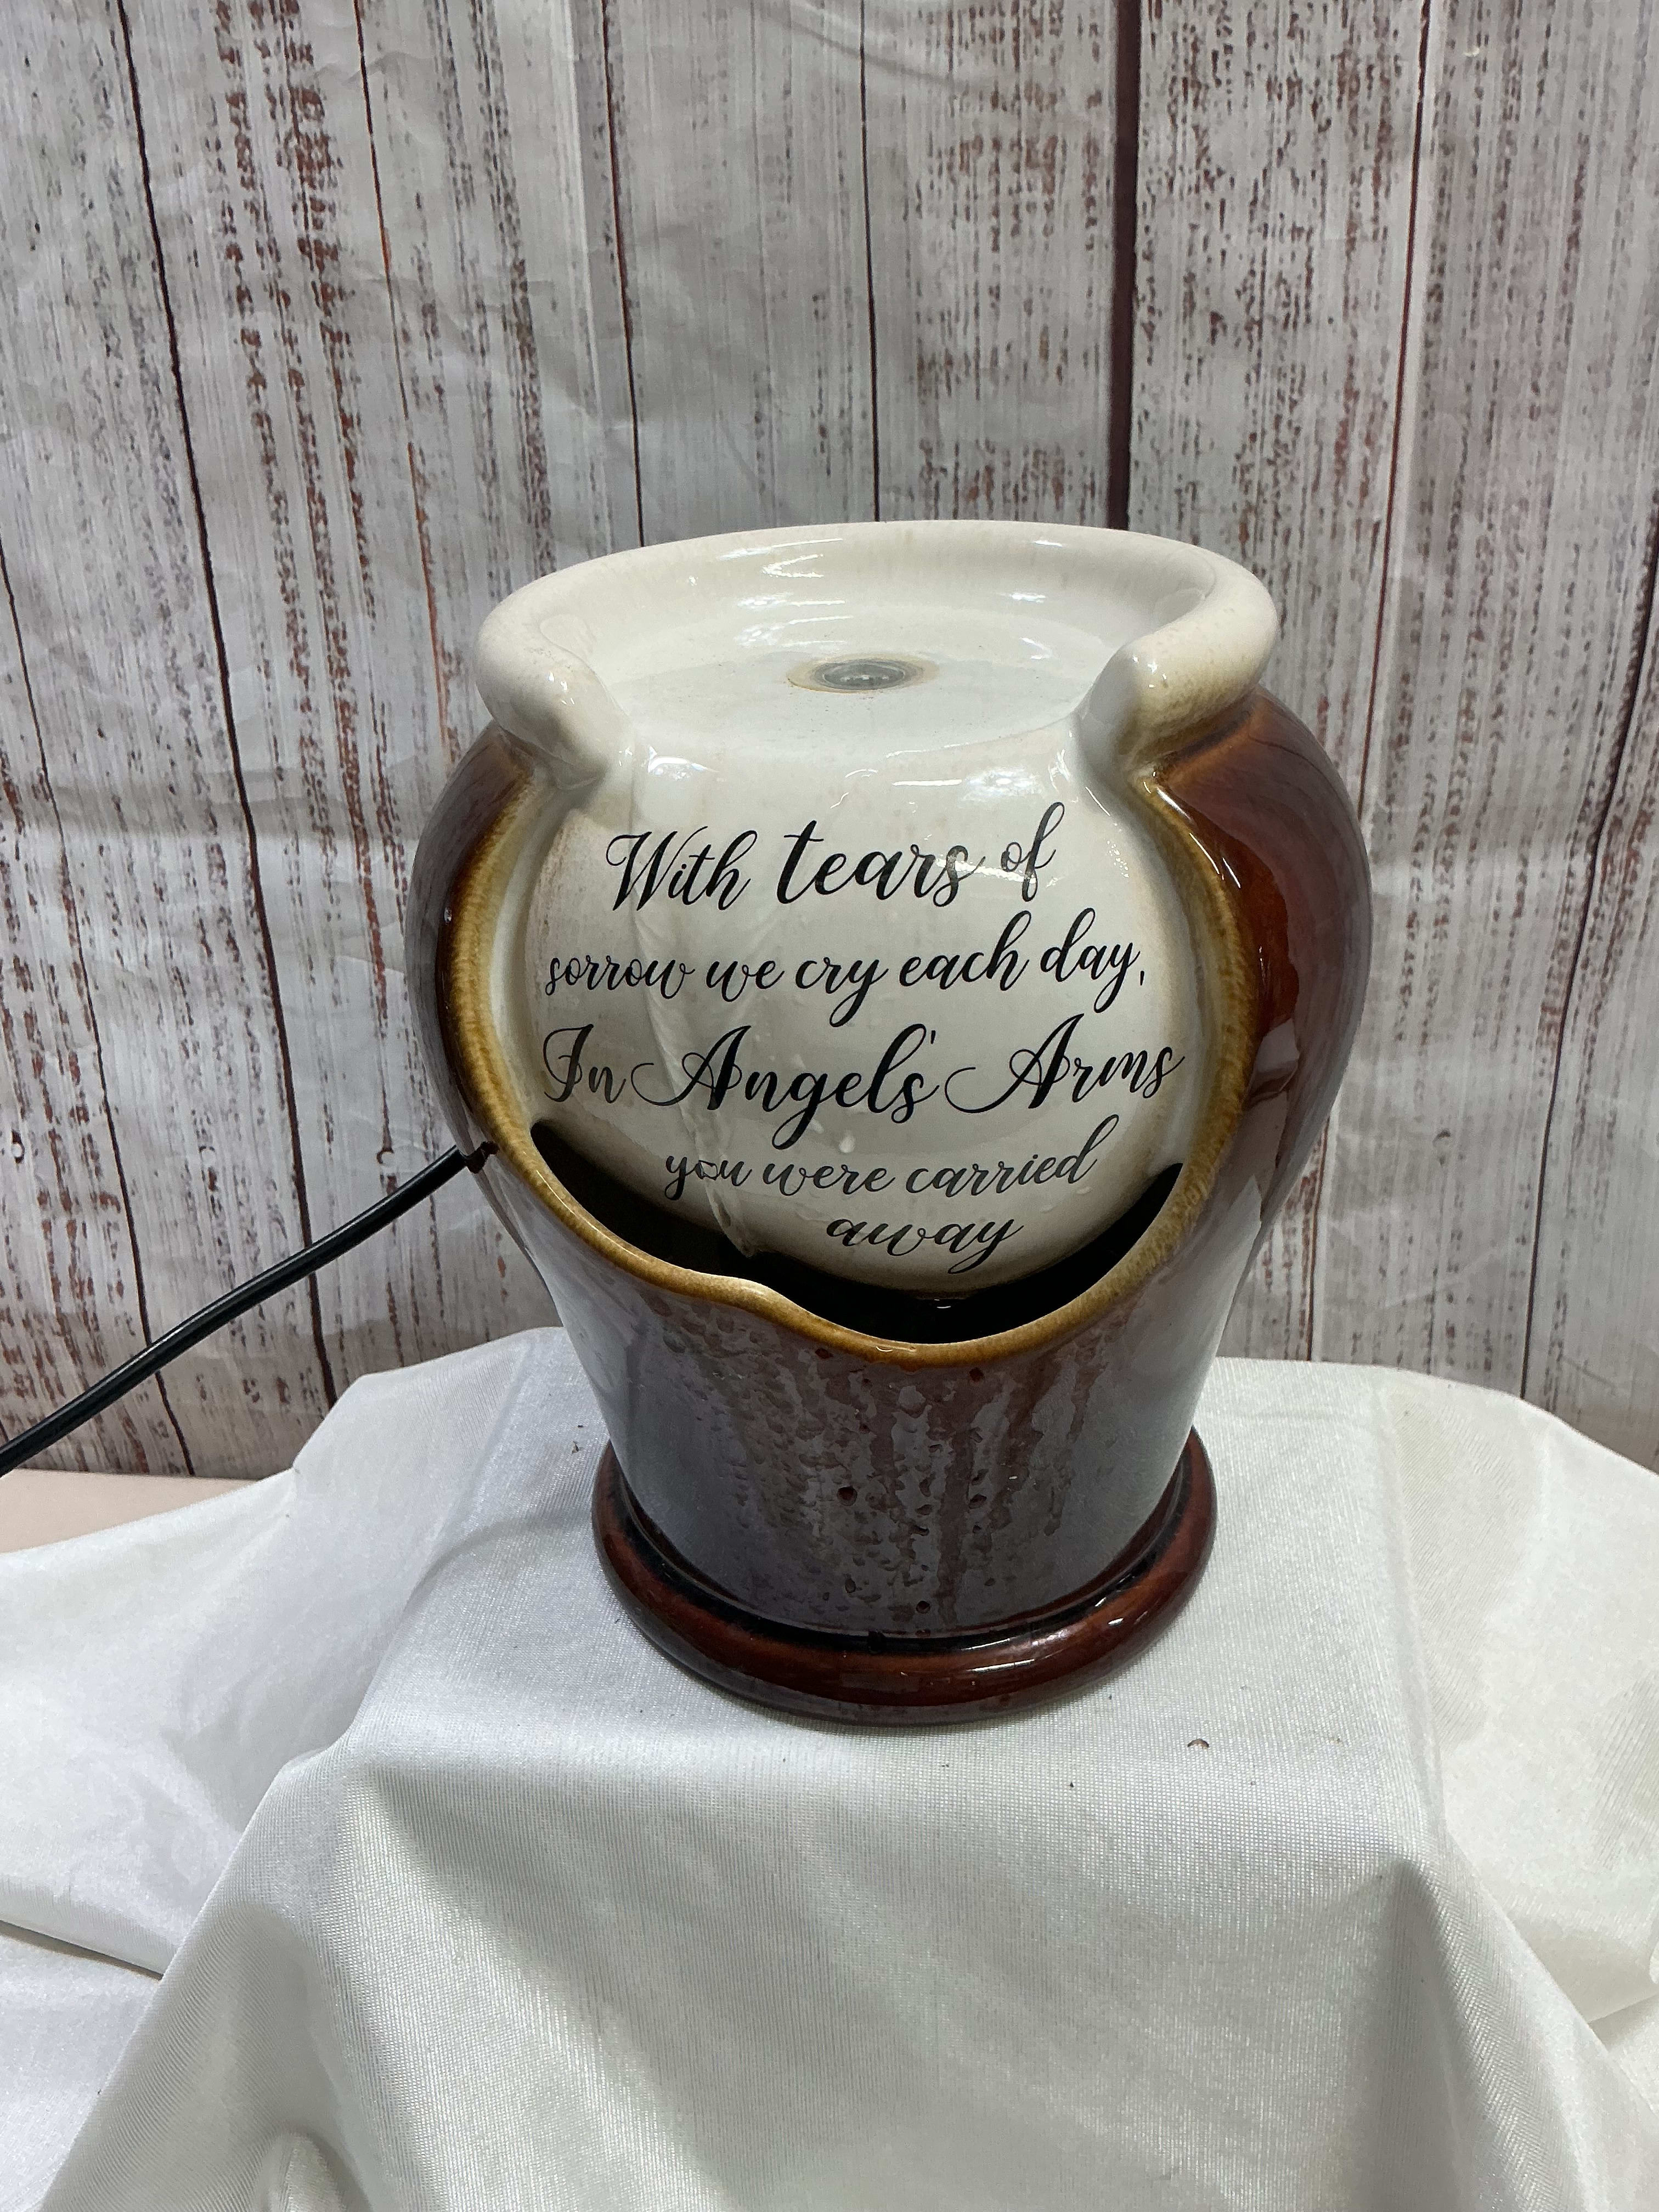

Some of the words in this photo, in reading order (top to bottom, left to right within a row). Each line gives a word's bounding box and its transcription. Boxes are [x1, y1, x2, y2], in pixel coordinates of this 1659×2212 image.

[605, 825, 759, 912] With
[776, 819, 986, 908] tears
[1000, 801, 1065, 902] of
[544, 955, 696, 1000] sorrow
[706, 960, 785, 1002] we
[795, 956, 890, 1028] cry
[899, 910, 1032, 991] each
[1040, 907, 1146, 1014] day,
[542, 1023, 627, 1104] In
[630, 1023, 940, 1150] Angels'
[944, 1013, 1186, 1114] Arms
[664, 1154, 753, 1201] you
[763, 1162, 896, 1197] were
[905, 1114, 1120, 1198] carried
[826, 1217, 1025, 1275] away
